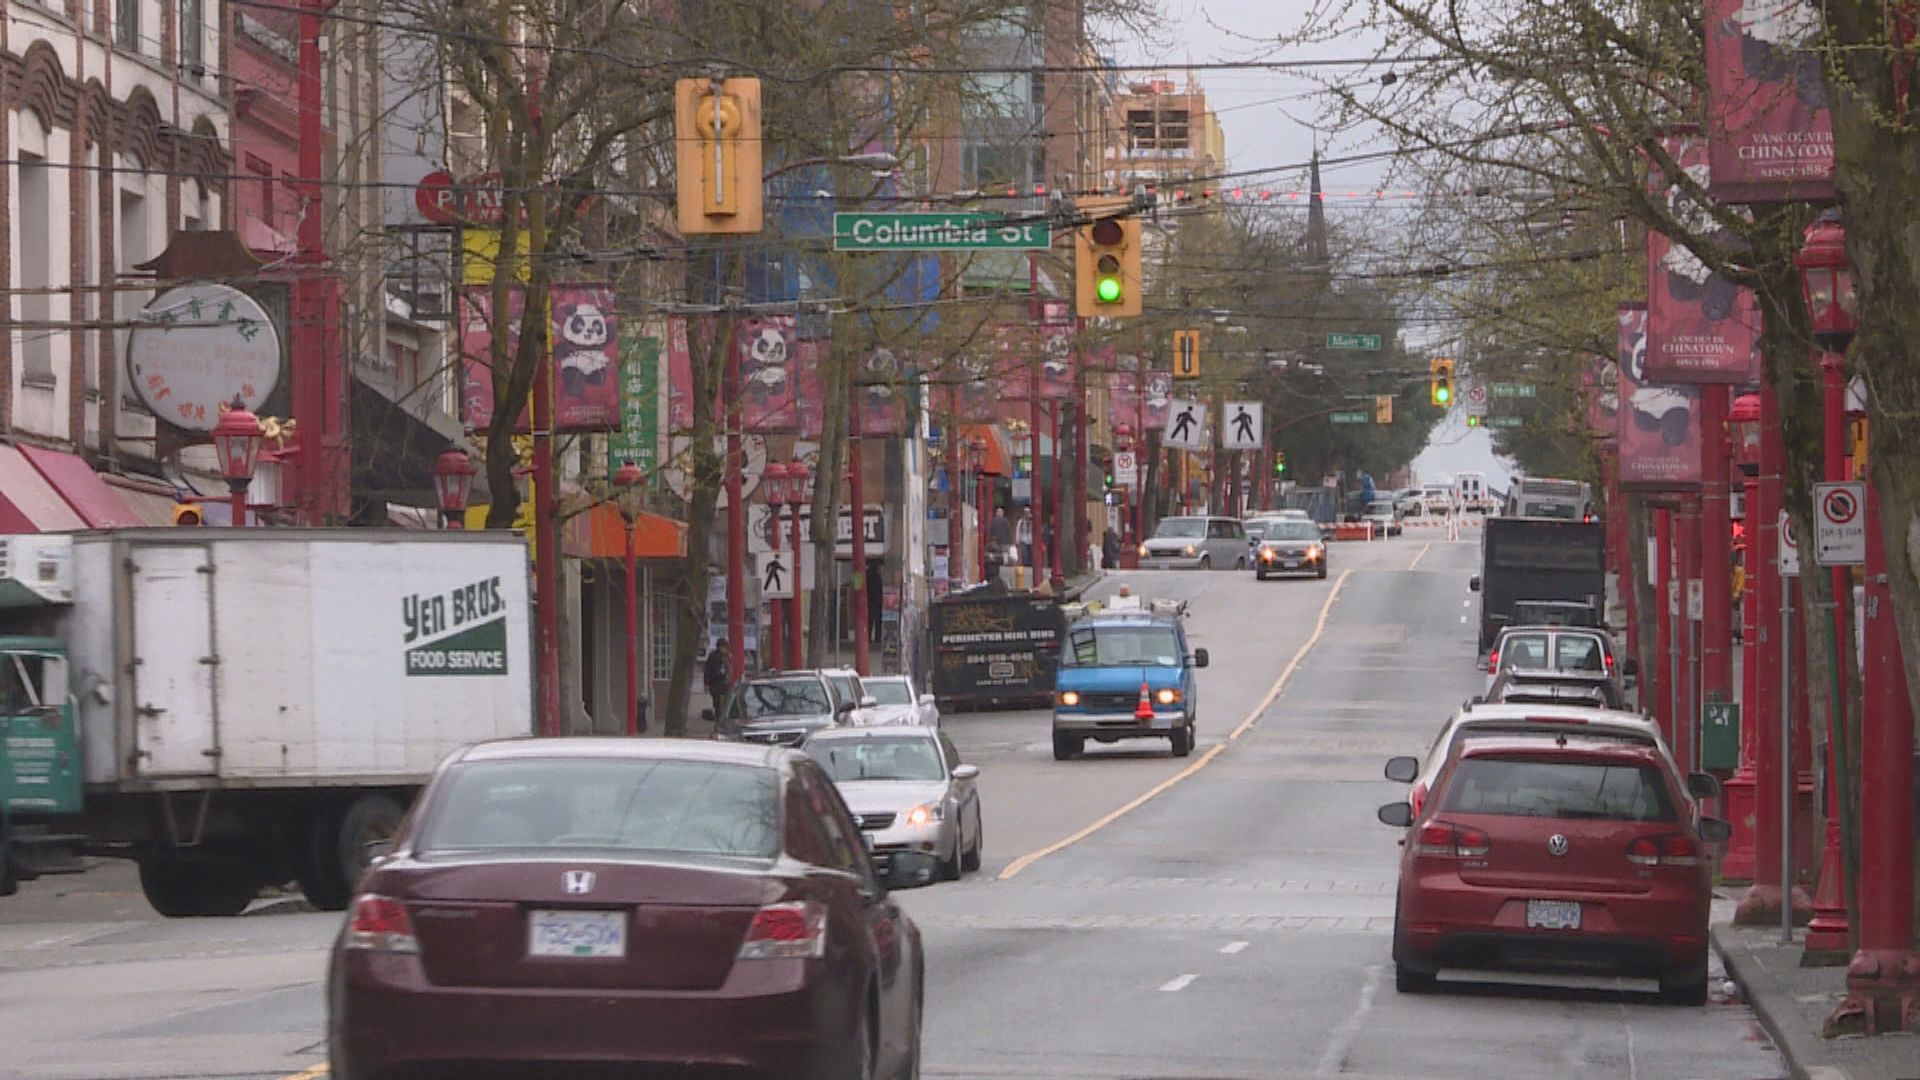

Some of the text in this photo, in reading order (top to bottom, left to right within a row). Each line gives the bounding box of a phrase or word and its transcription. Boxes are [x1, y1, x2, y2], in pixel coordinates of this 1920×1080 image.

[1738, 144, 1833, 159] CHINATOW
[853, 218, 1034, 244] Columbia St
[1662, 343, 1735, 355] CHINATOWN
[452, 575, 506, 626] BROS.
[410, 651, 503, 668] FOOD SERVICE
